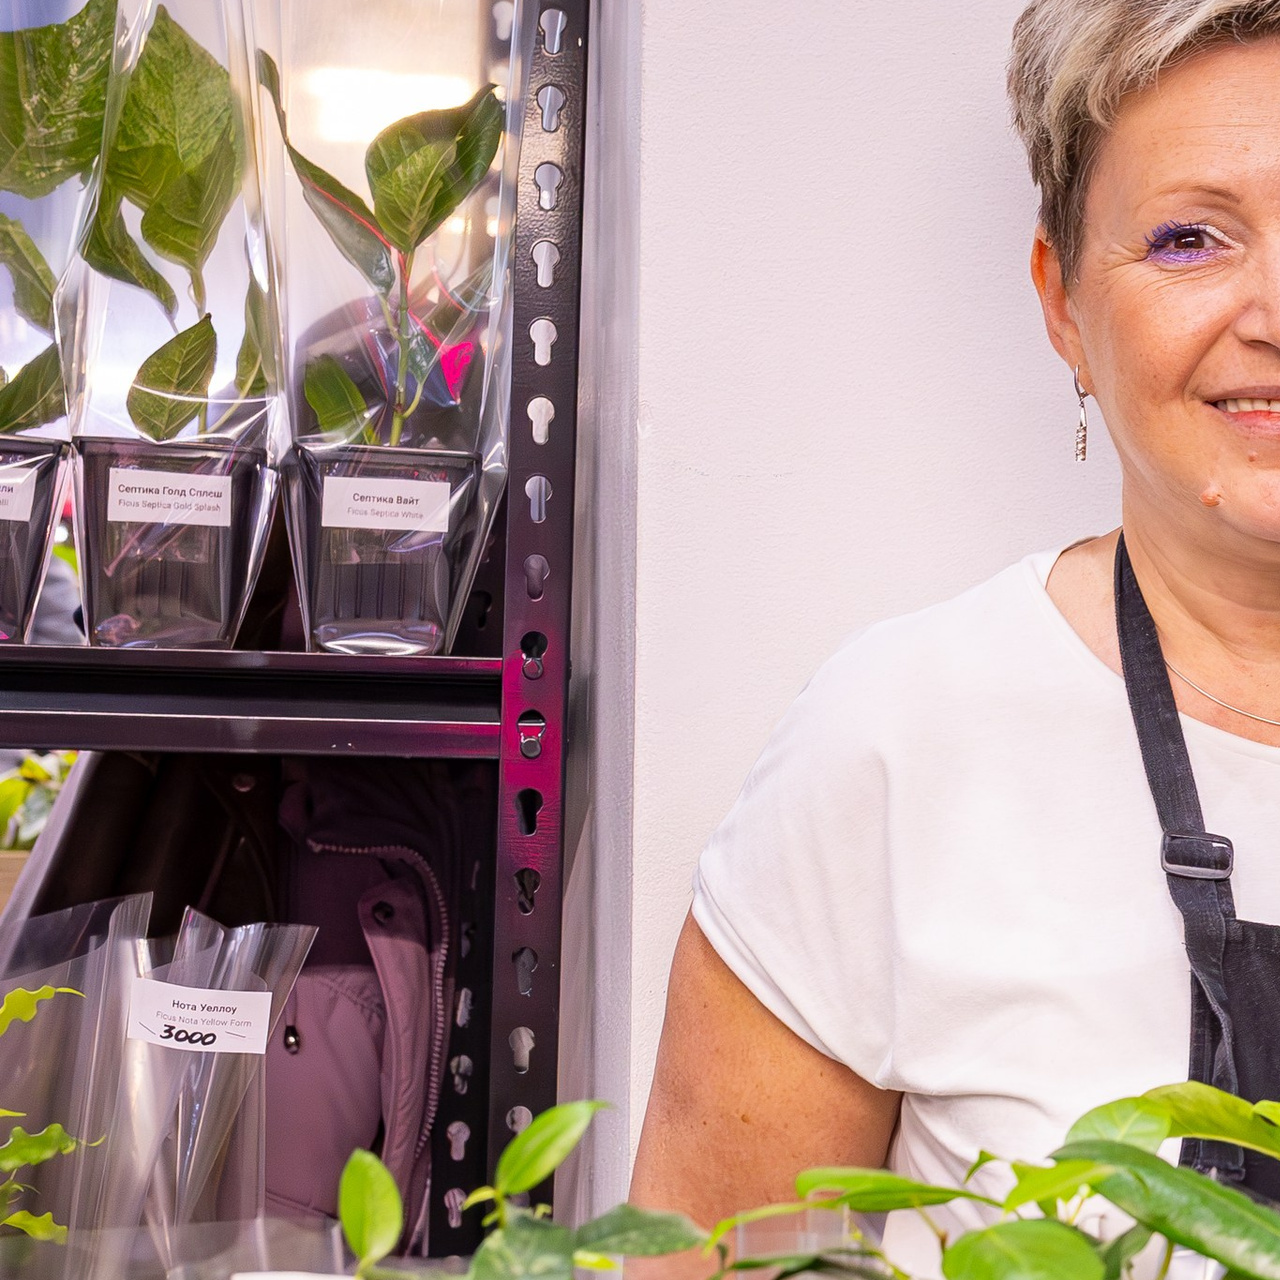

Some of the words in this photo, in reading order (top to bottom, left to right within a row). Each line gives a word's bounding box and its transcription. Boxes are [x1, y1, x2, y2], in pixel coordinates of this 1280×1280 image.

[118, 484, 160, 495] Септика
[162, 486, 187, 497] Голд
[189, 488, 223, 499] Сплеш
[118, 499, 140, 507] Ficus
[141, 500, 172, 511] Septica
[173, 501, 192, 510] Gold
[352, 493, 393, 504] Септика
[396, 495, 420, 506] Вайт
[347, 507, 368, 516] Ficus
[370, 507, 399, 518] Septica
[401, 511, 424, 519] White
[172, 1000, 197, 1011] Нота
[200, 1004, 237, 1015] Уеллоу
[155, 1011, 176, 1022] Ficus
[178, 1016, 198, 1025] Nota
[200, 1018, 228, 1027] Yellow
[230, 1019, 252, 1027] Form
[160, 1024, 217, 1046] 3000
